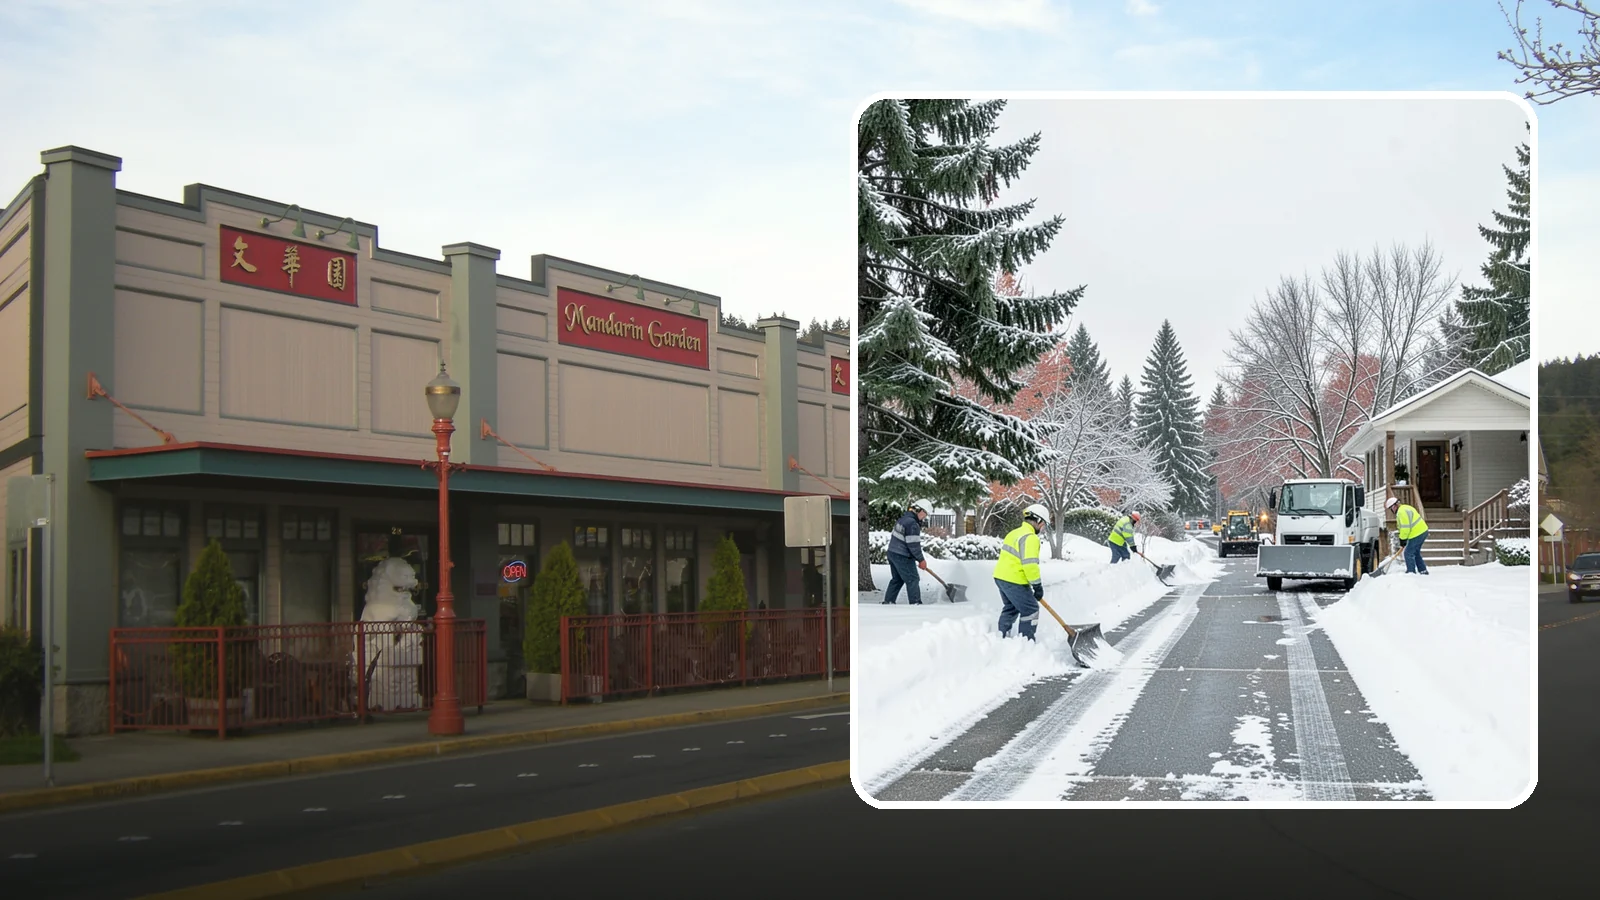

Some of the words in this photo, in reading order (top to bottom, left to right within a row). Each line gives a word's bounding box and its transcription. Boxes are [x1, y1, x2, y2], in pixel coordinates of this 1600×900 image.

[565, 302, 644, 341] Mandarin
[648, 320, 702, 352] Garden
[503, 565, 527, 578] OPEN
